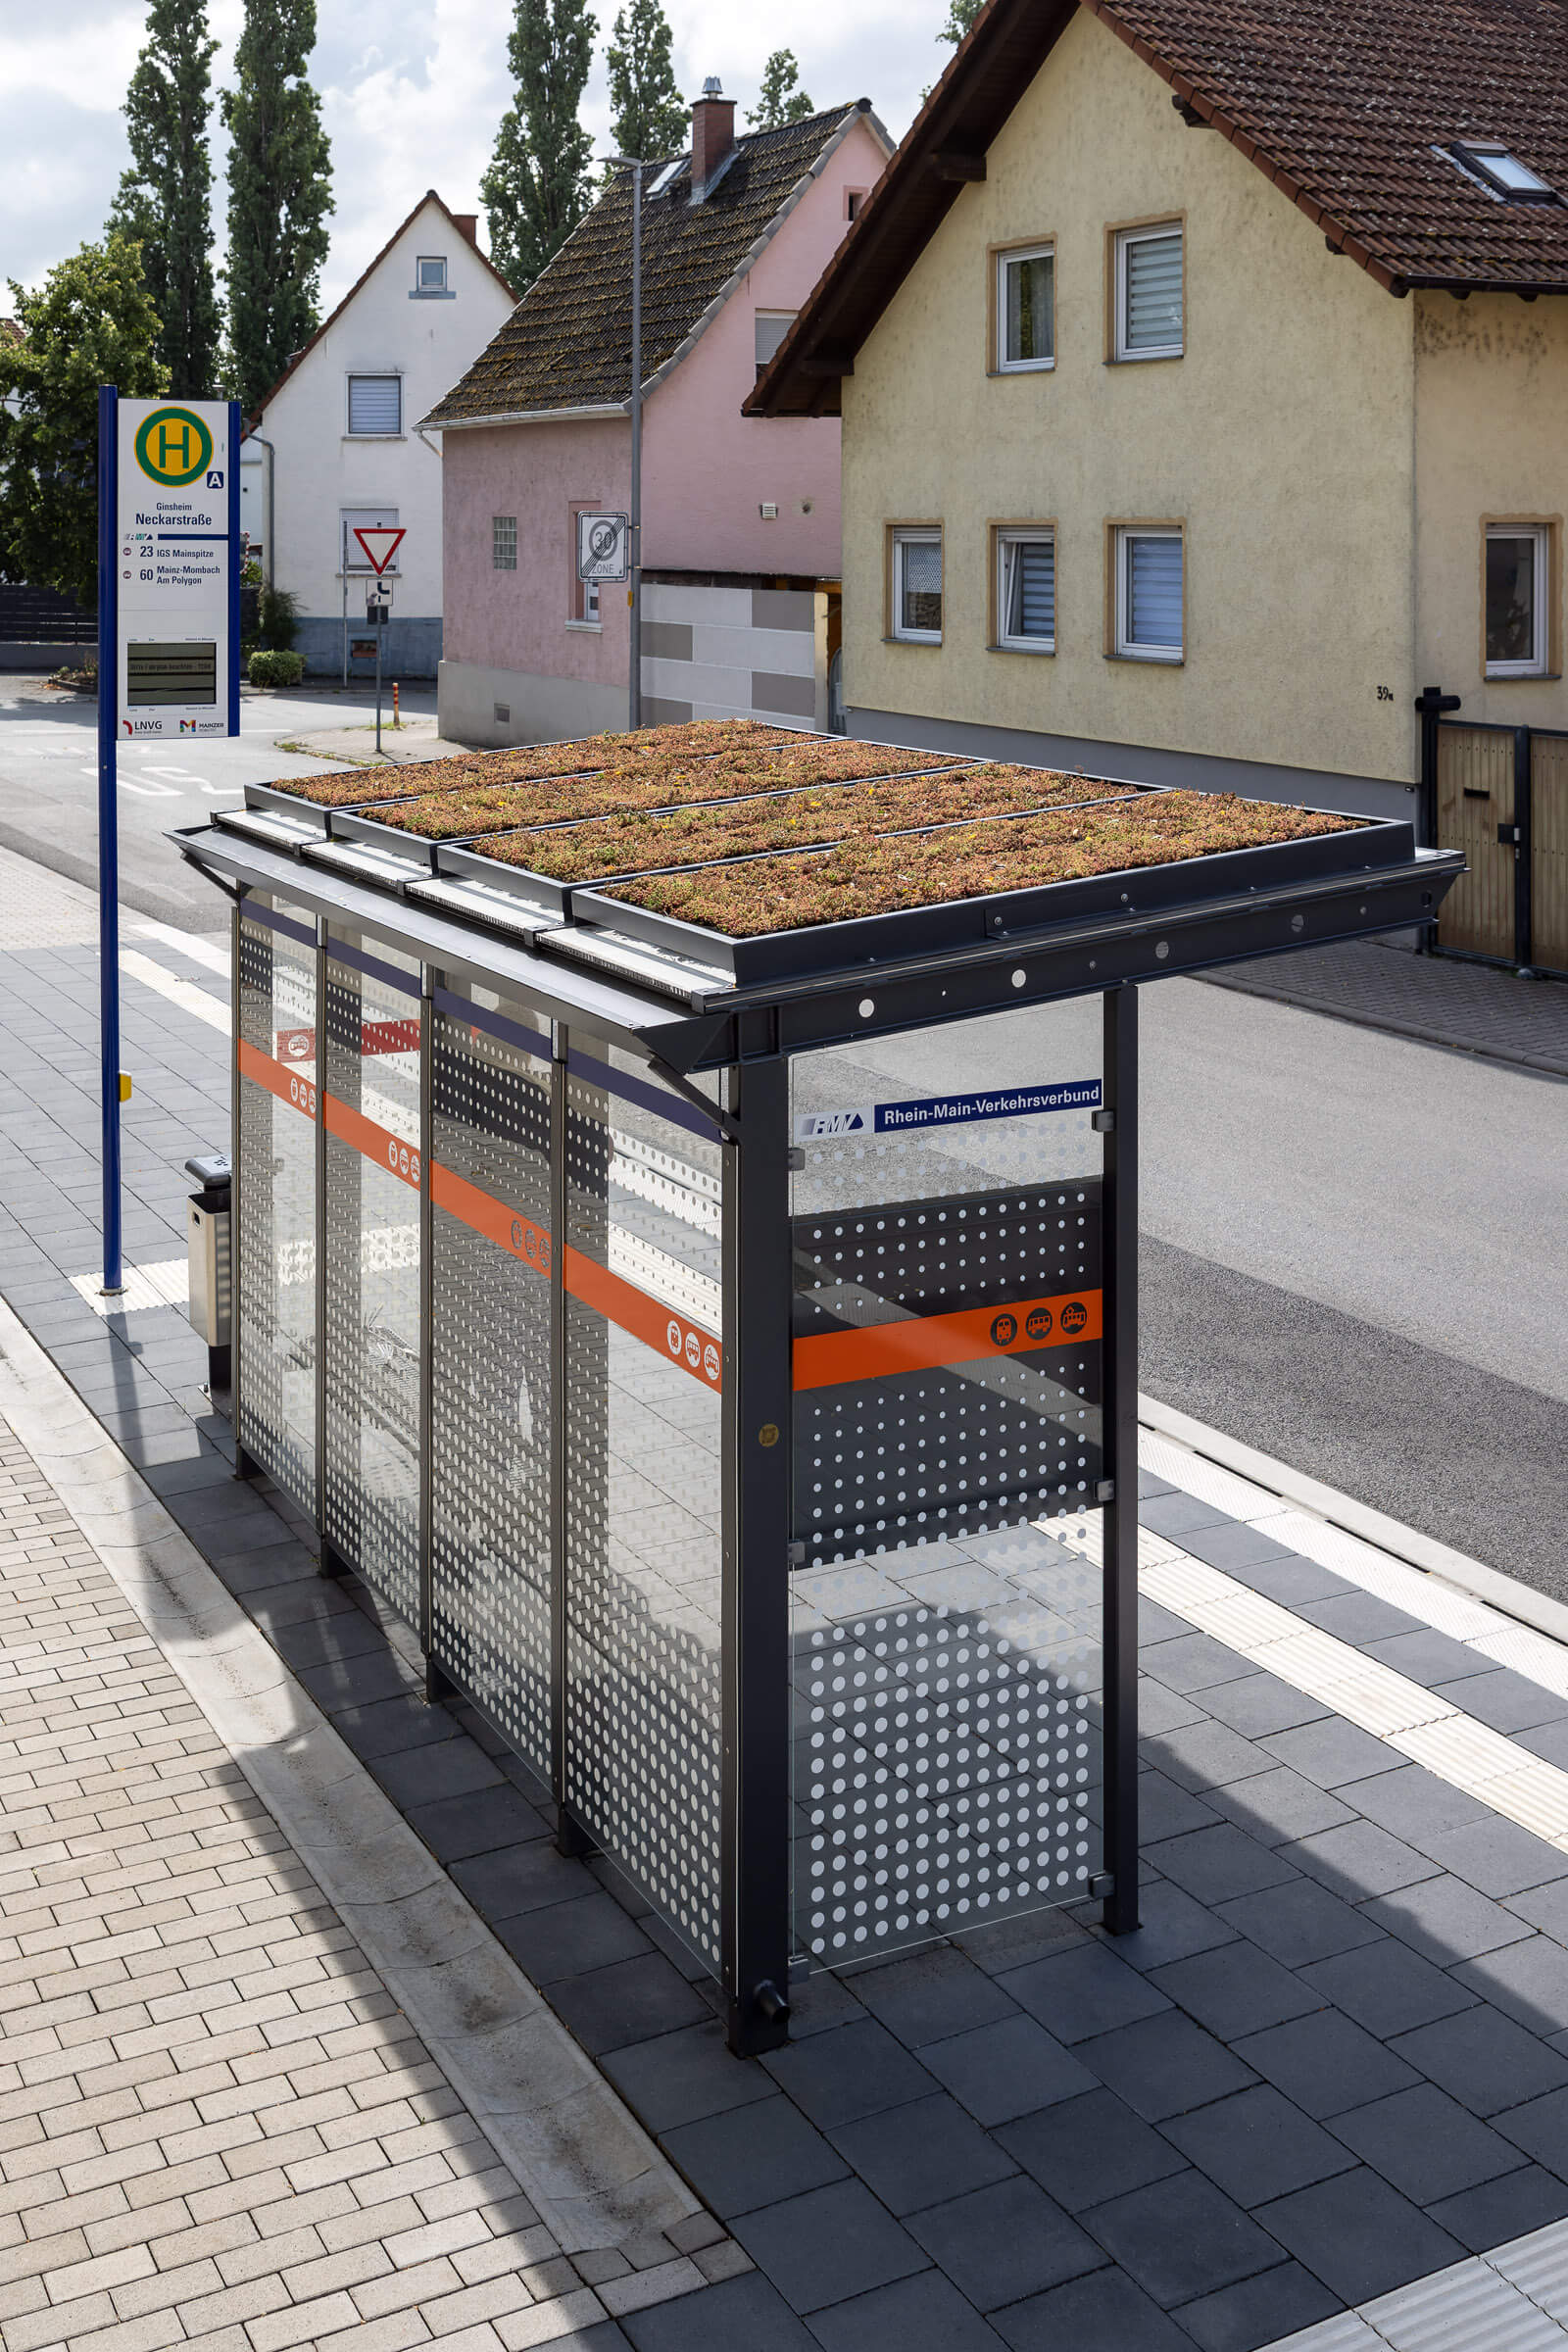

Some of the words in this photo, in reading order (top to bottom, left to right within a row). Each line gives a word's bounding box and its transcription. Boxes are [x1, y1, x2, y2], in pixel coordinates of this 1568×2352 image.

[159, 424, 190, 469] H
[209, 472, 222, 488] A
[156, 502, 192, 511] Ginsheim
[135, 513, 213, 525] Neckarstraße
[595, 531, 612, 550] 30
[140, 545, 154, 558] 23
[157, 549, 171, 558] IGS
[172, 549, 214, 560] Mainspitze
[140, 568, 154, 580] 60
[157, 565, 220, 574] Mainz-Mombach
[591, 564, 614, 574] ZONE
[157, 575, 170, 584] Am
[172, 575, 202, 585] Polygon
[134, 720, 163, 730] LNVG
[884, 1086, 1100, 1125] Rhein-Main-Verkehrsverbund
